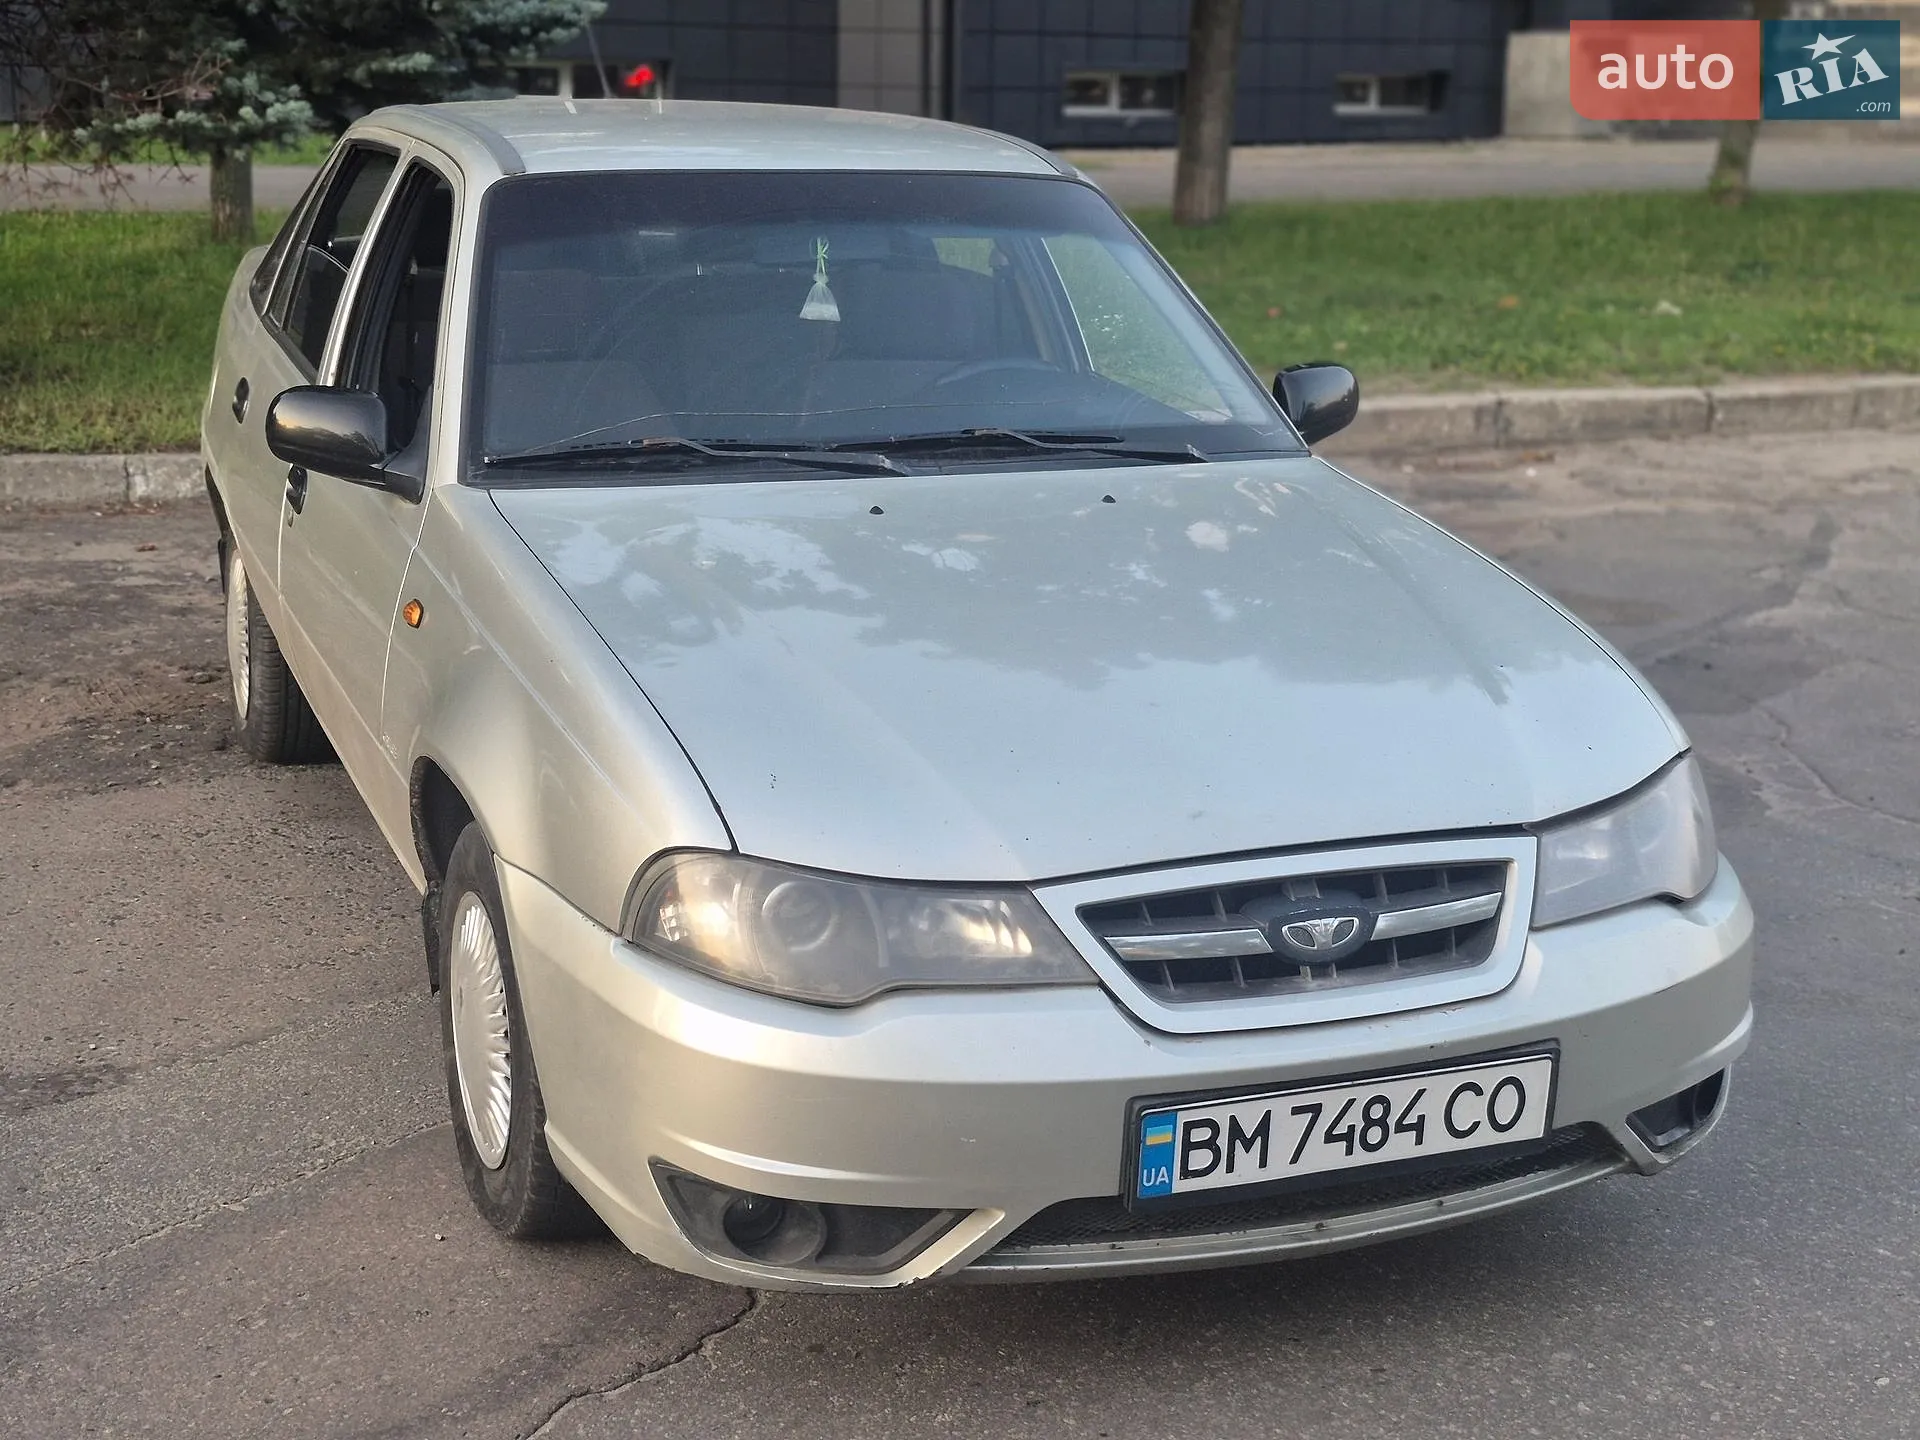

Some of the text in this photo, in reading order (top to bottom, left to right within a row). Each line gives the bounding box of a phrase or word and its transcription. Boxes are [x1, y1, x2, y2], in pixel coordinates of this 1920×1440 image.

[1179, 1076, 1527, 1181] BM 7484 CO
[1143, 1165, 1170, 1188] UA
